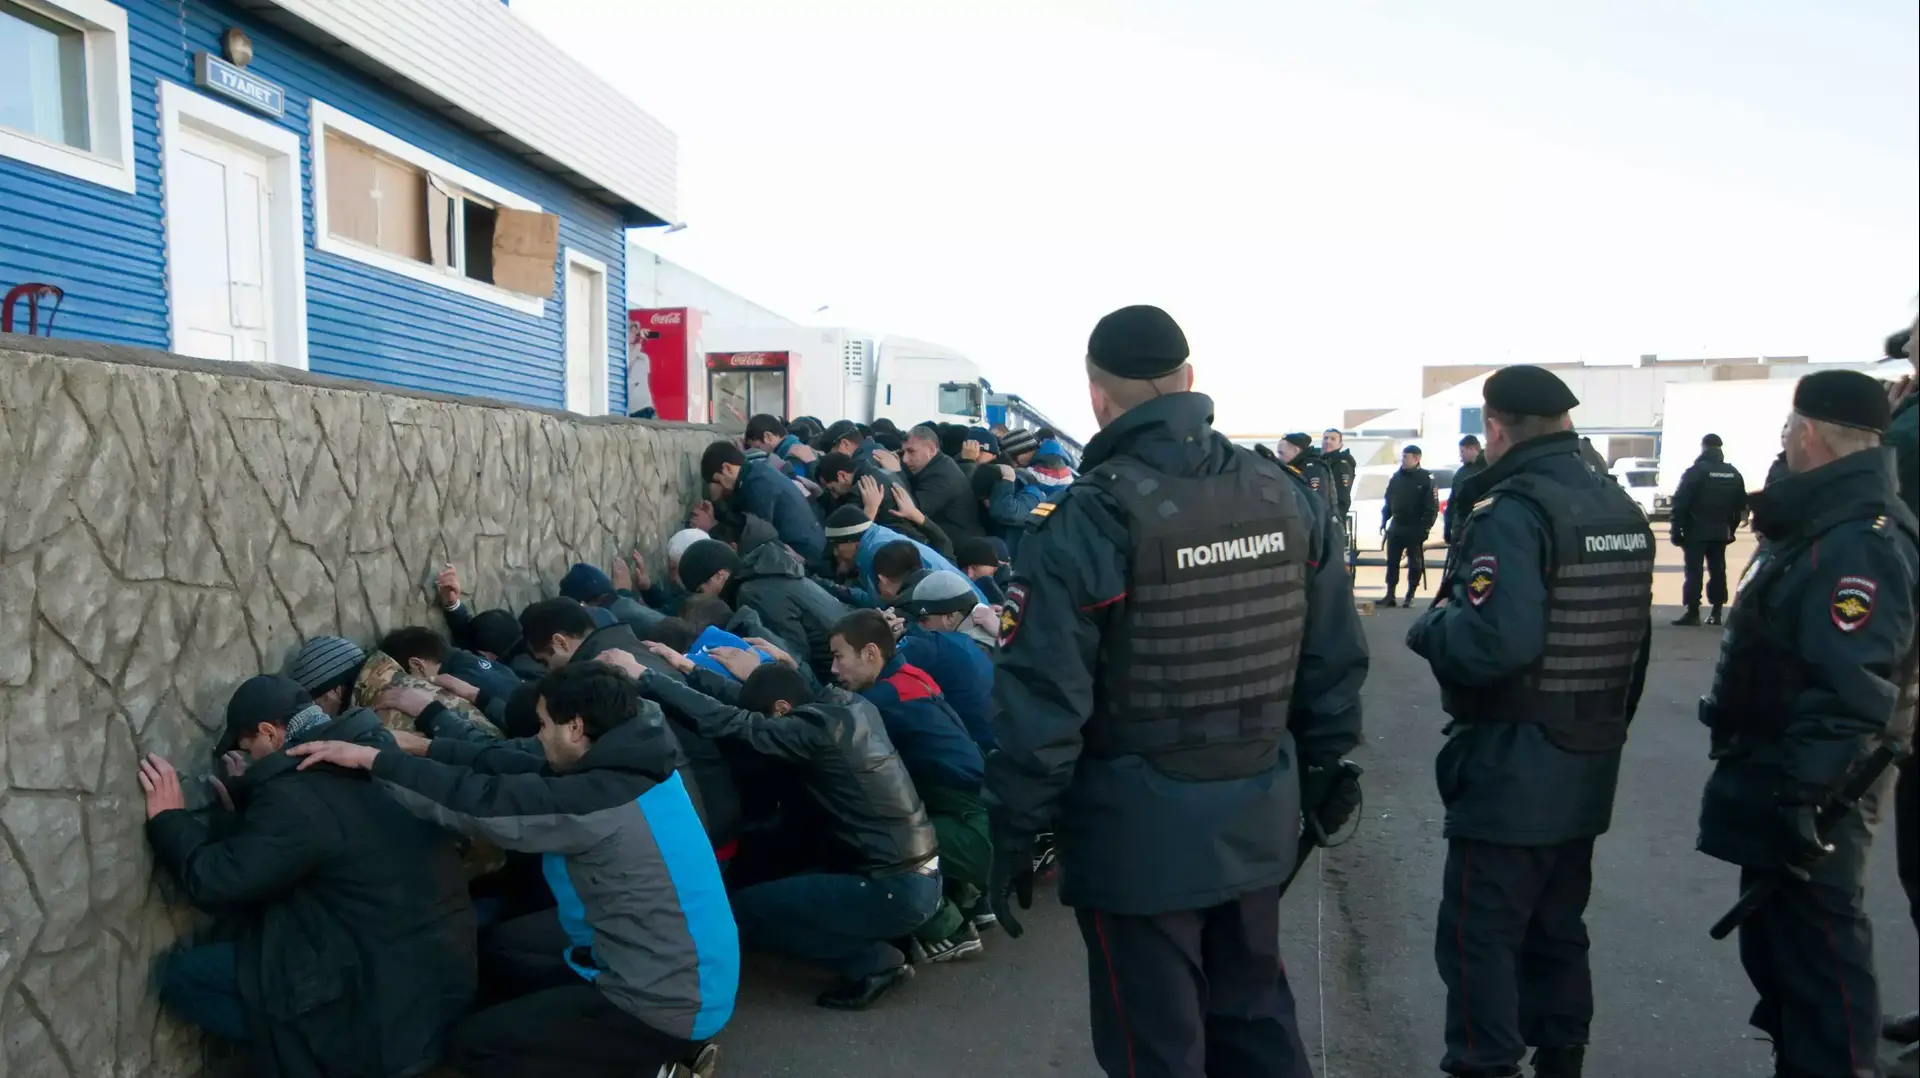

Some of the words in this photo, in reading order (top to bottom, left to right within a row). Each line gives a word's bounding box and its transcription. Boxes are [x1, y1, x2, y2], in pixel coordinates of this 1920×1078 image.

[220, 69, 271, 104] ТУАЛЕТ
[1176, 531, 1286, 570] ПОЛИЦИЯ
[1584, 533, 1648, 552] ПОЛИЦИЯ
[1838, 589, 1871, 603] РОССИЯ
